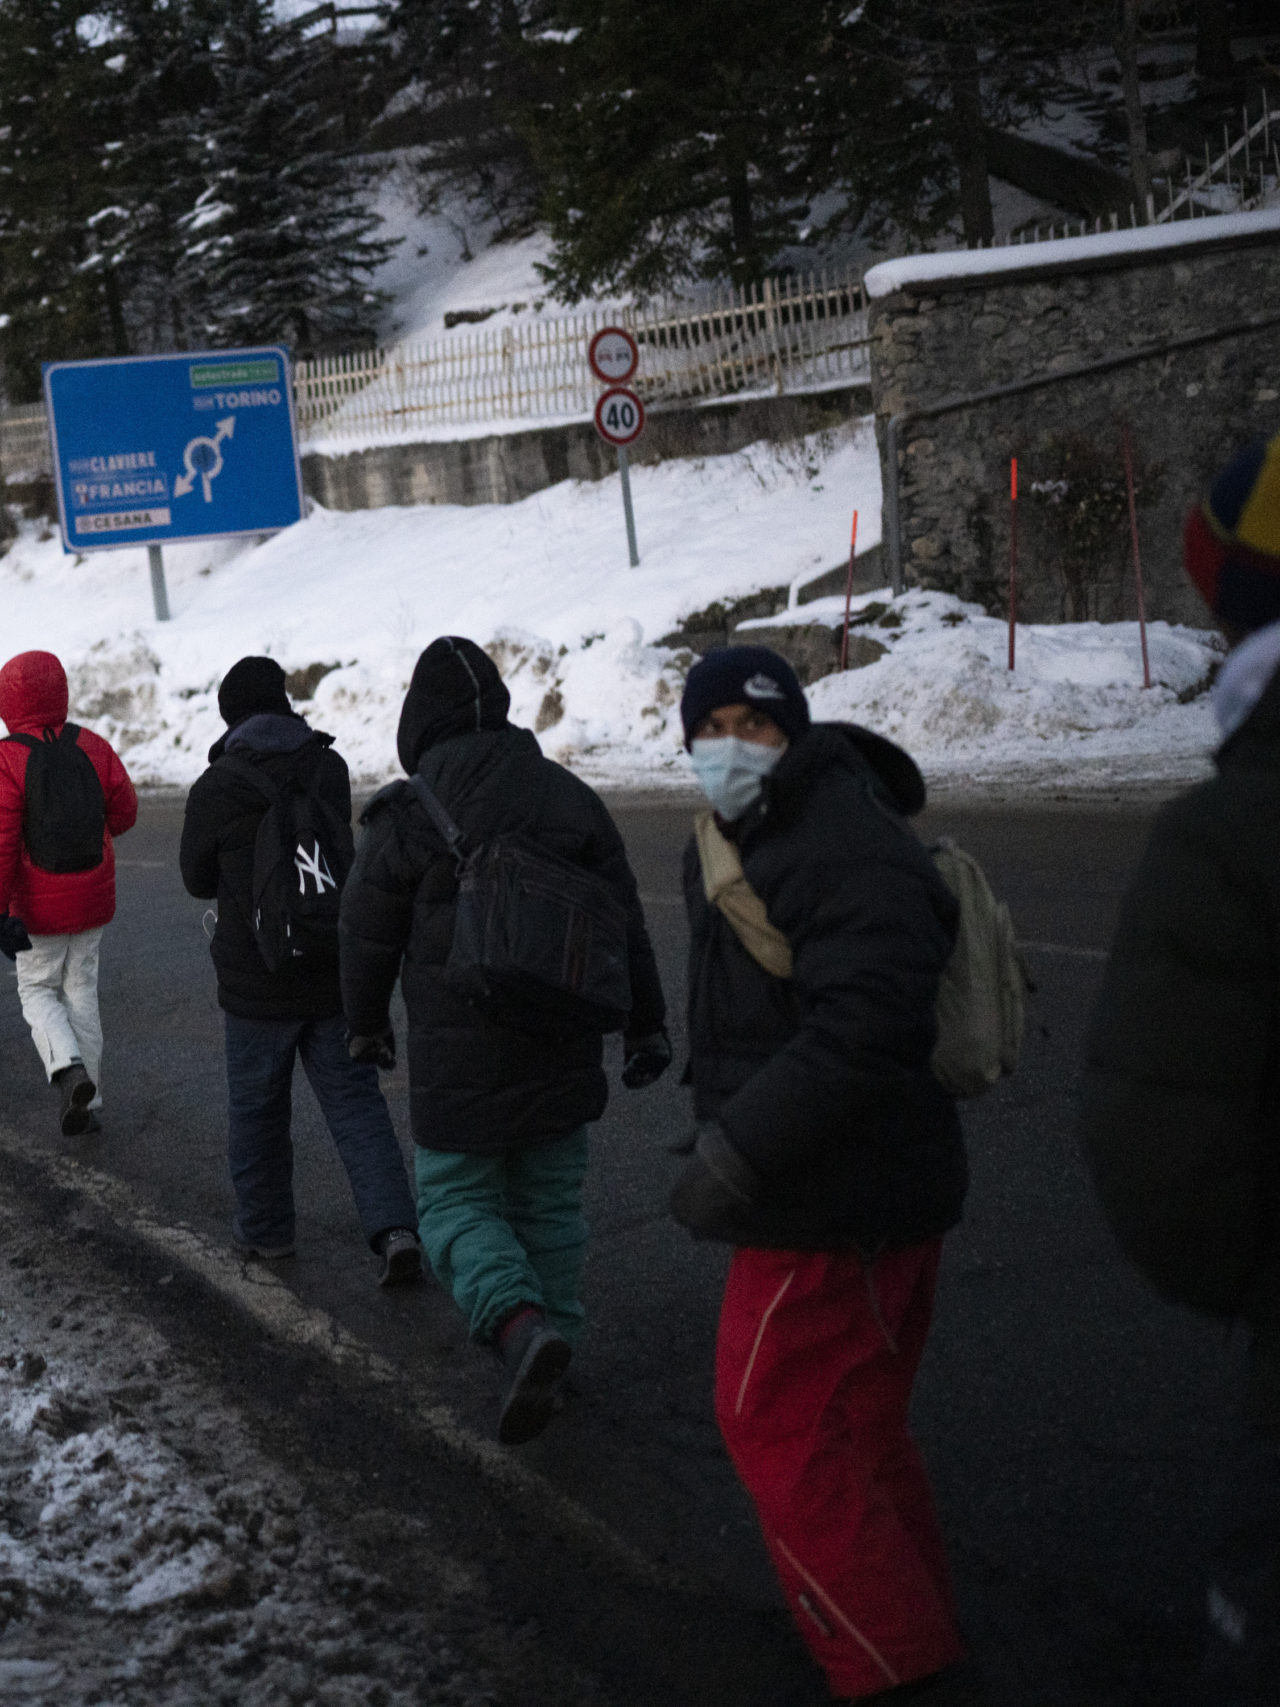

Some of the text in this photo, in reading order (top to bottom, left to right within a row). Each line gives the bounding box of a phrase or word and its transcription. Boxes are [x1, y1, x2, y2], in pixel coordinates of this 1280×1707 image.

[215, 389, 281, 409] TORINO
[607, 403, 634, 430] 40
[90, 451, 156, 472] CLAVIERE
[89, 479, 166, 499] FRANCIA
[94, 513, 152, 529] CESANA
[294, 839, 337, 896] NY
